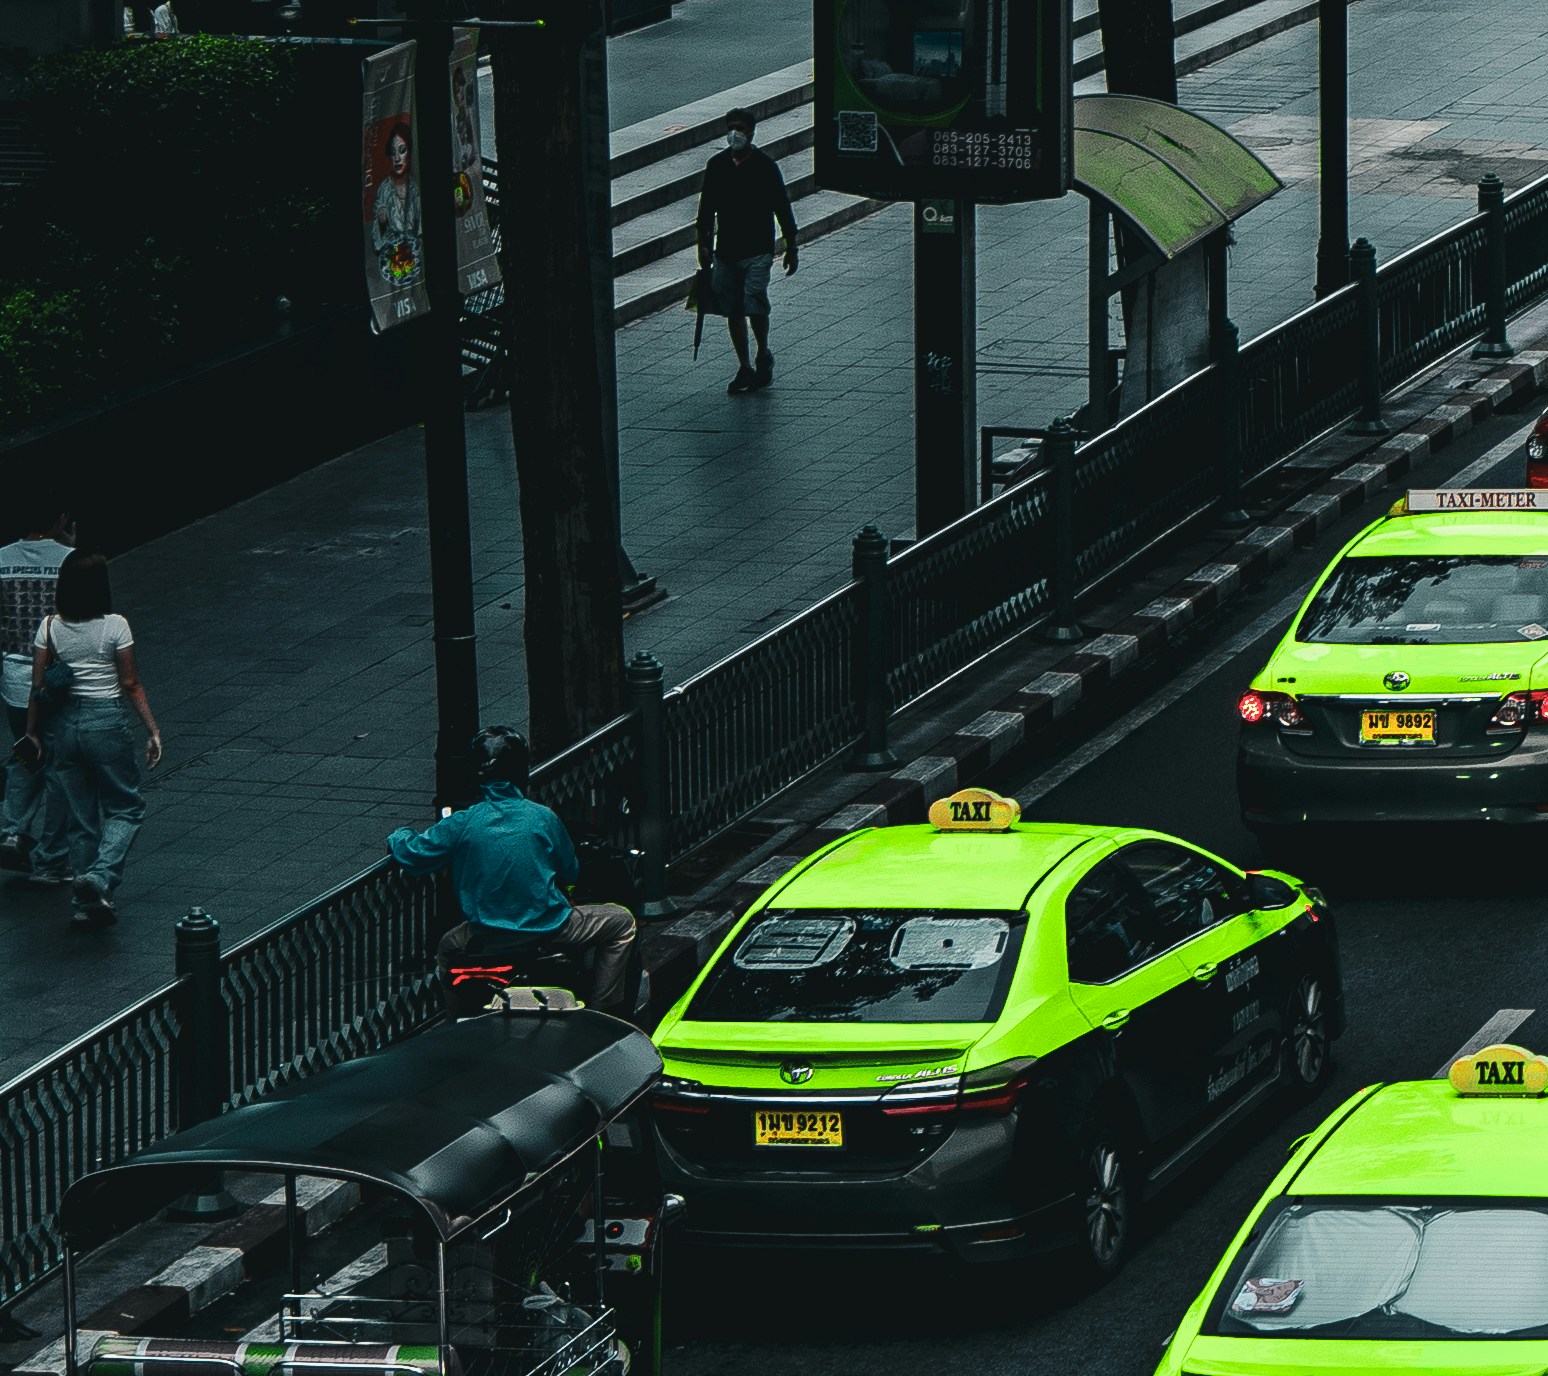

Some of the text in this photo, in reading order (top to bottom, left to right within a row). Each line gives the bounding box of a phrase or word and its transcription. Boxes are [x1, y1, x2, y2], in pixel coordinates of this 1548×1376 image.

[932, 132, 1033, 145] 065-205-2413
[932, 143, 1033, 157] 083-127-3705
[932, 154, 1033, 168] 083-127-3706
[1435, 491, 1537, 508] TAXI-METER
[1397, 713, 1432, 729] 9892
[950, 801, 992, 823] TAXI
[1475, 1060, 1525, 1086] TAXI
[797, 1111, 841, 1132] 9212
